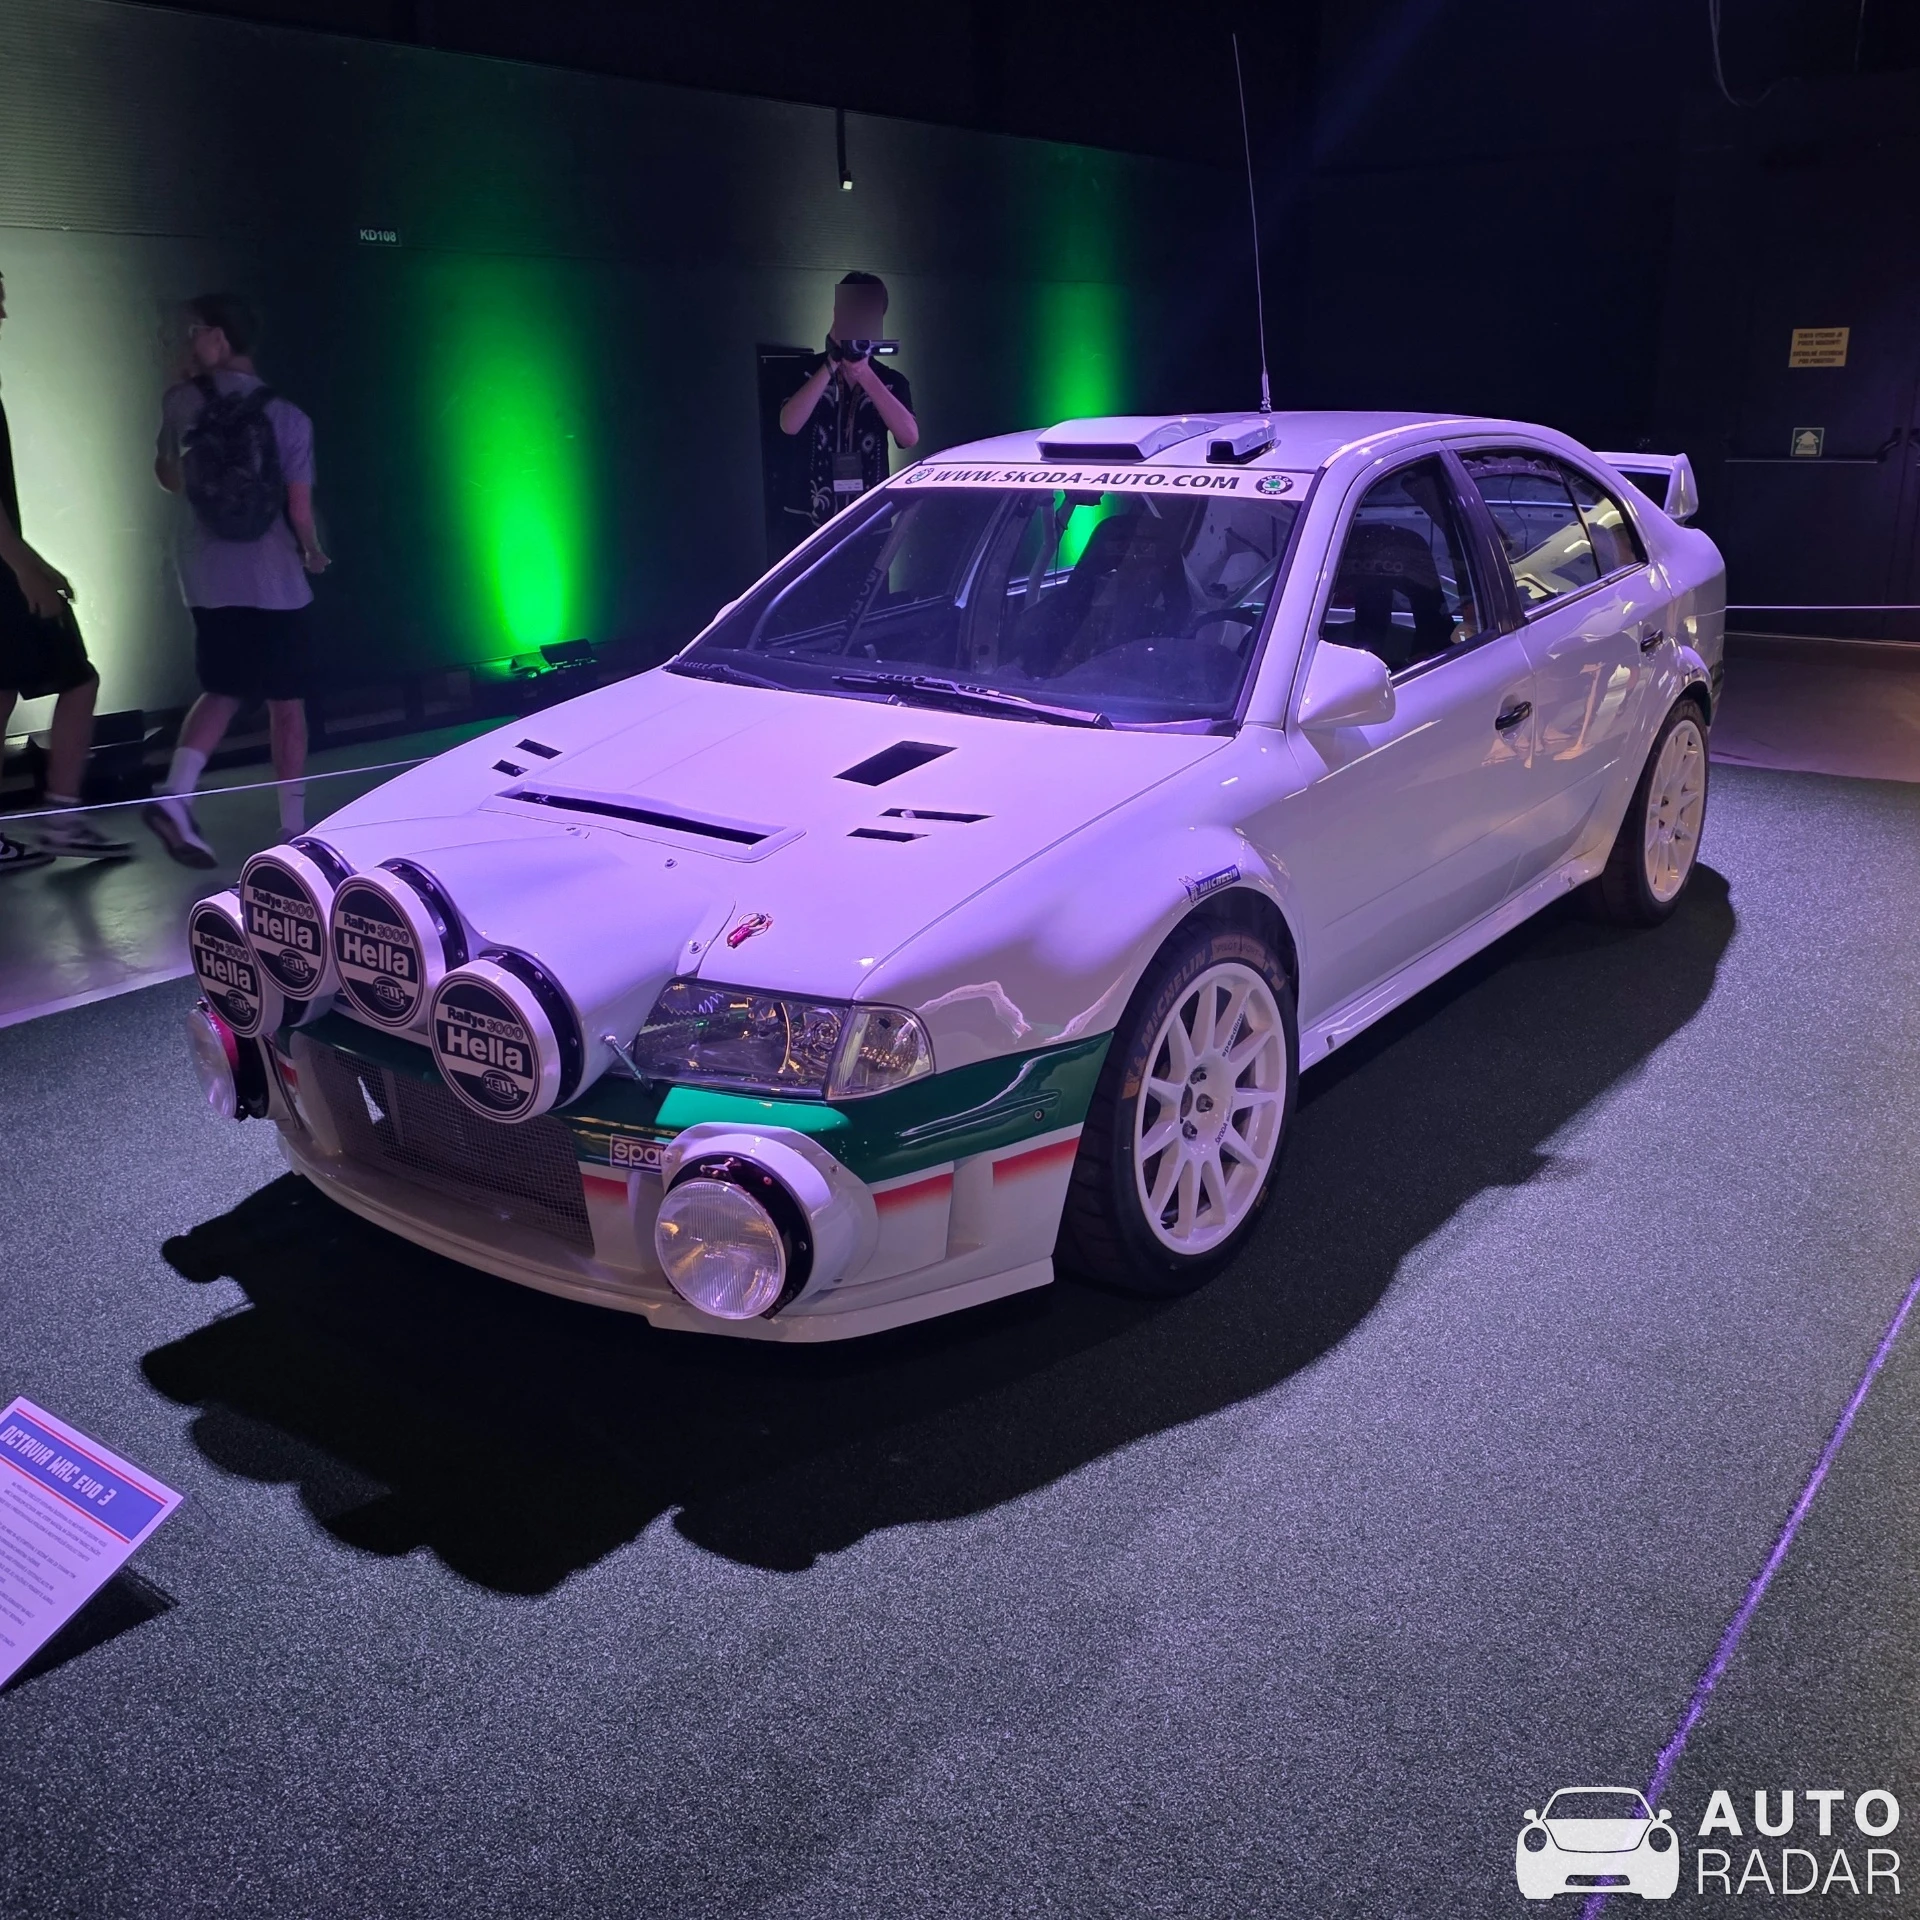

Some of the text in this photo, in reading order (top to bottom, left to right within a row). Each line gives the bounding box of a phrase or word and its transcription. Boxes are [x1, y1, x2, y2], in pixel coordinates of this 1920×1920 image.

[360, 229, 397, 243] KD108
[931, 470, 1240, 490] WWW.SKODA-AUTO.COM
[252, 888, 315, 920] Rallye 3000
[200, 931, 250, 963] Rallye 3000
[252, 906, 313, 951] Hella
[344, 912, 410, 945] Rallye 3000
[202, 950, 252, 991] Hella
[343, 933, 409, 977] Hella
[1141, 949, 1207, 1051] MICHELIN
[447, 1006, 524, 1041] Rallye 3000
[1221, 1012, 1244, 1058] speedline
[447, 1025, 523, 1072] Hella
[0, 1425, 118, 1507] OCTAVIA WRC EVO 3
